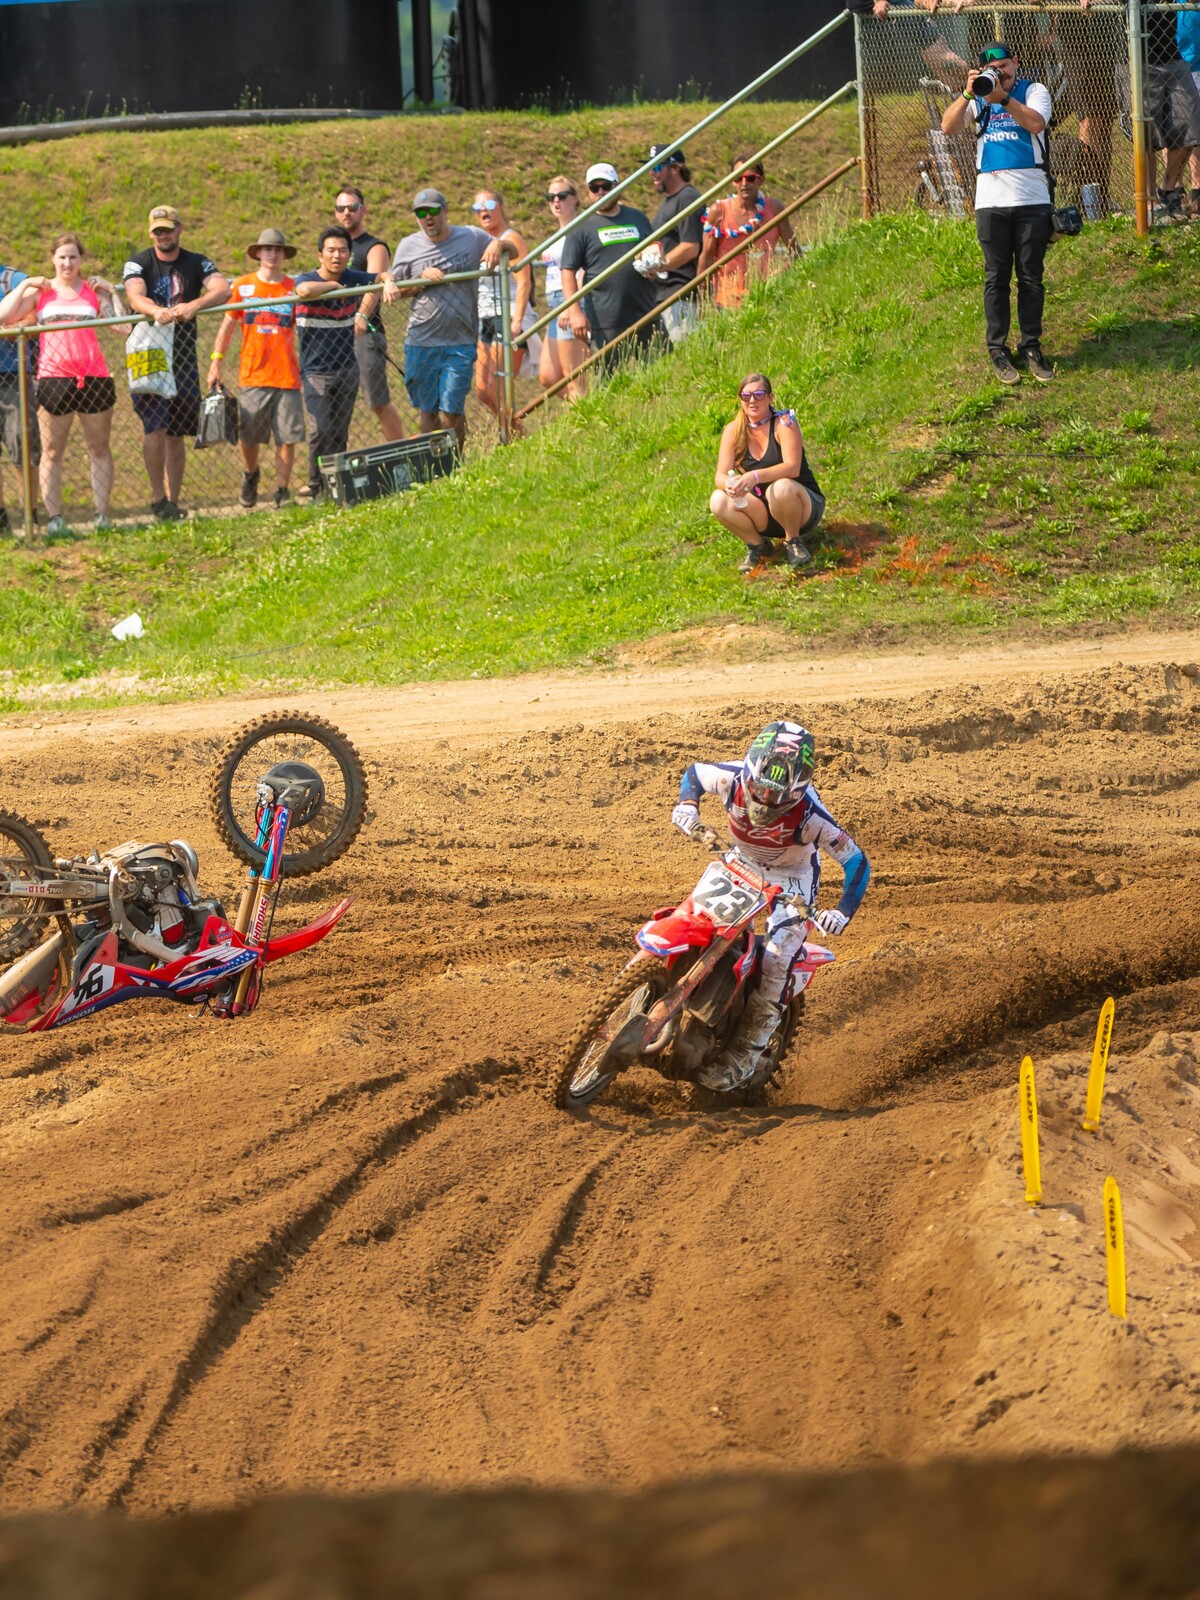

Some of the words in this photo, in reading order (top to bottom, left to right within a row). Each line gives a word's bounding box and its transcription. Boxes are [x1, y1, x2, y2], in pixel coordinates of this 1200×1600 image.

[983, 131, 1019, 143] PHOTO
[126, 348, 166, 368] MOTO
[694, 877, 754, 924] 23
[253, 898, 269, 941] SHOWA
[72, 964, 104, 1009] 94
[56, 1006, 96, 1026] HONDA
